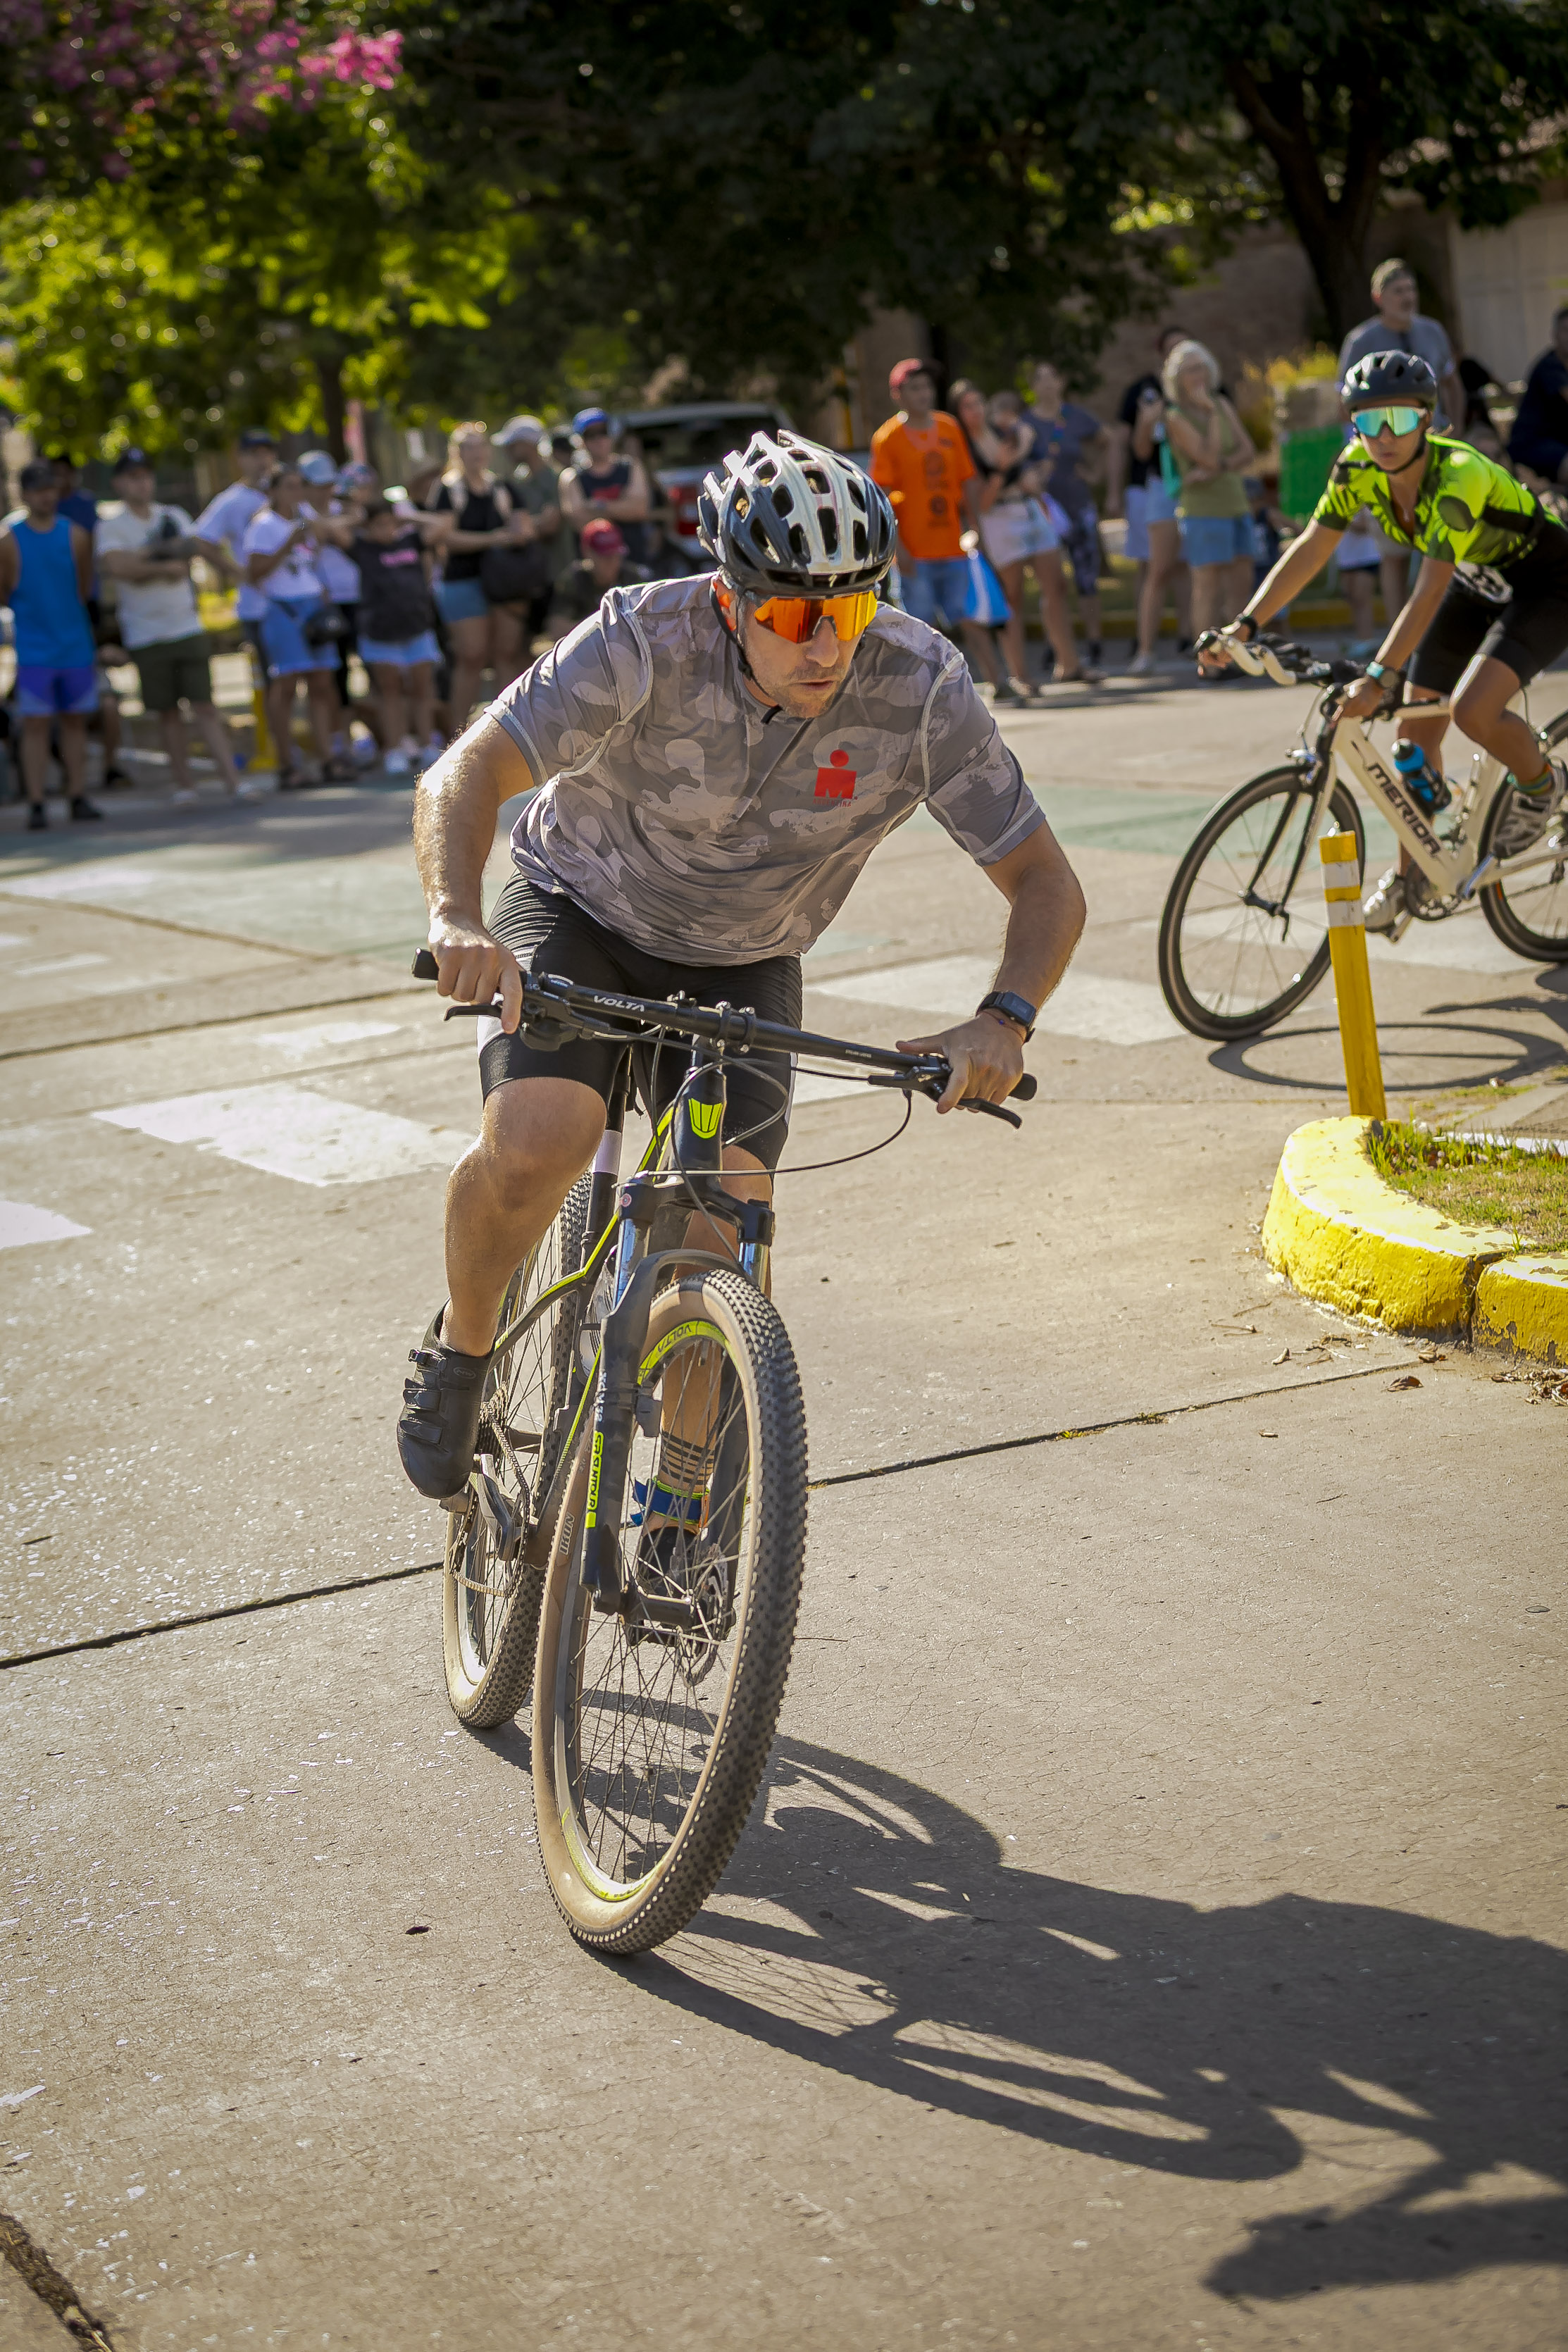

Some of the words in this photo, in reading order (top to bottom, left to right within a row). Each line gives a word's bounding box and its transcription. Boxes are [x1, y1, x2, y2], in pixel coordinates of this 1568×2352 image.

[1367, 763, 1441, 858] MERIDA
[594, 995, 645, 1012] VOLTA
[657, 1324, 692, 1353] VOLTA
[559, 1512, 575, 1555] IKON
